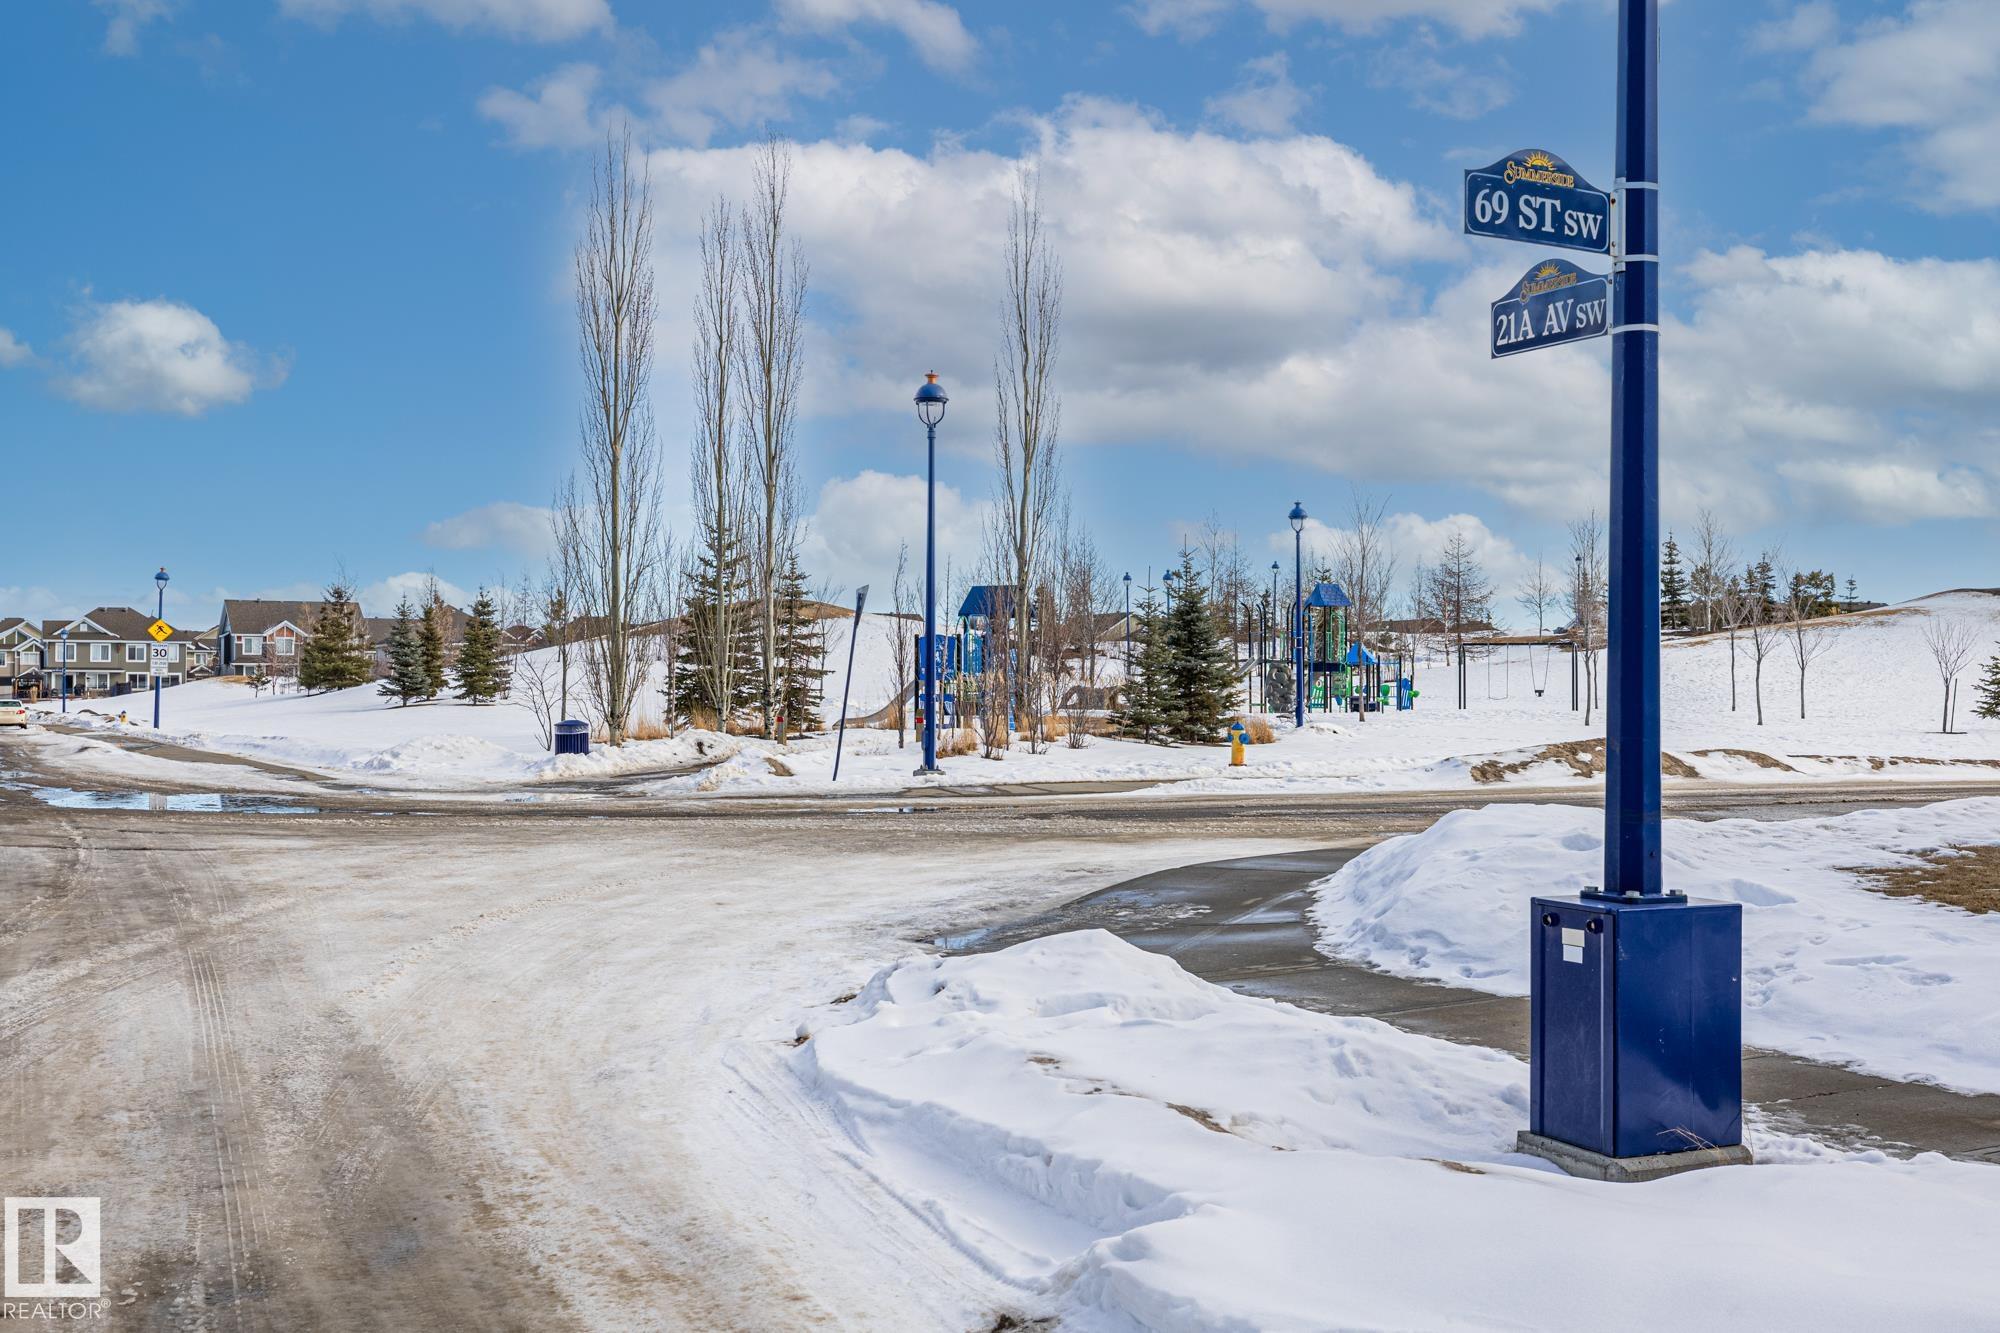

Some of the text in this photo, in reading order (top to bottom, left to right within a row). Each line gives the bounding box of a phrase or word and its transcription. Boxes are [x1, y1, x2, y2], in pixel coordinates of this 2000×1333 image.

[1504, 160, 1575, 188] SUMMERSIDE
[1475, 188, 1603, 240] 69 ST SW
[1496, 298, 1606, 346] 21A AV SW
[152, 648, 168, 658] 30
